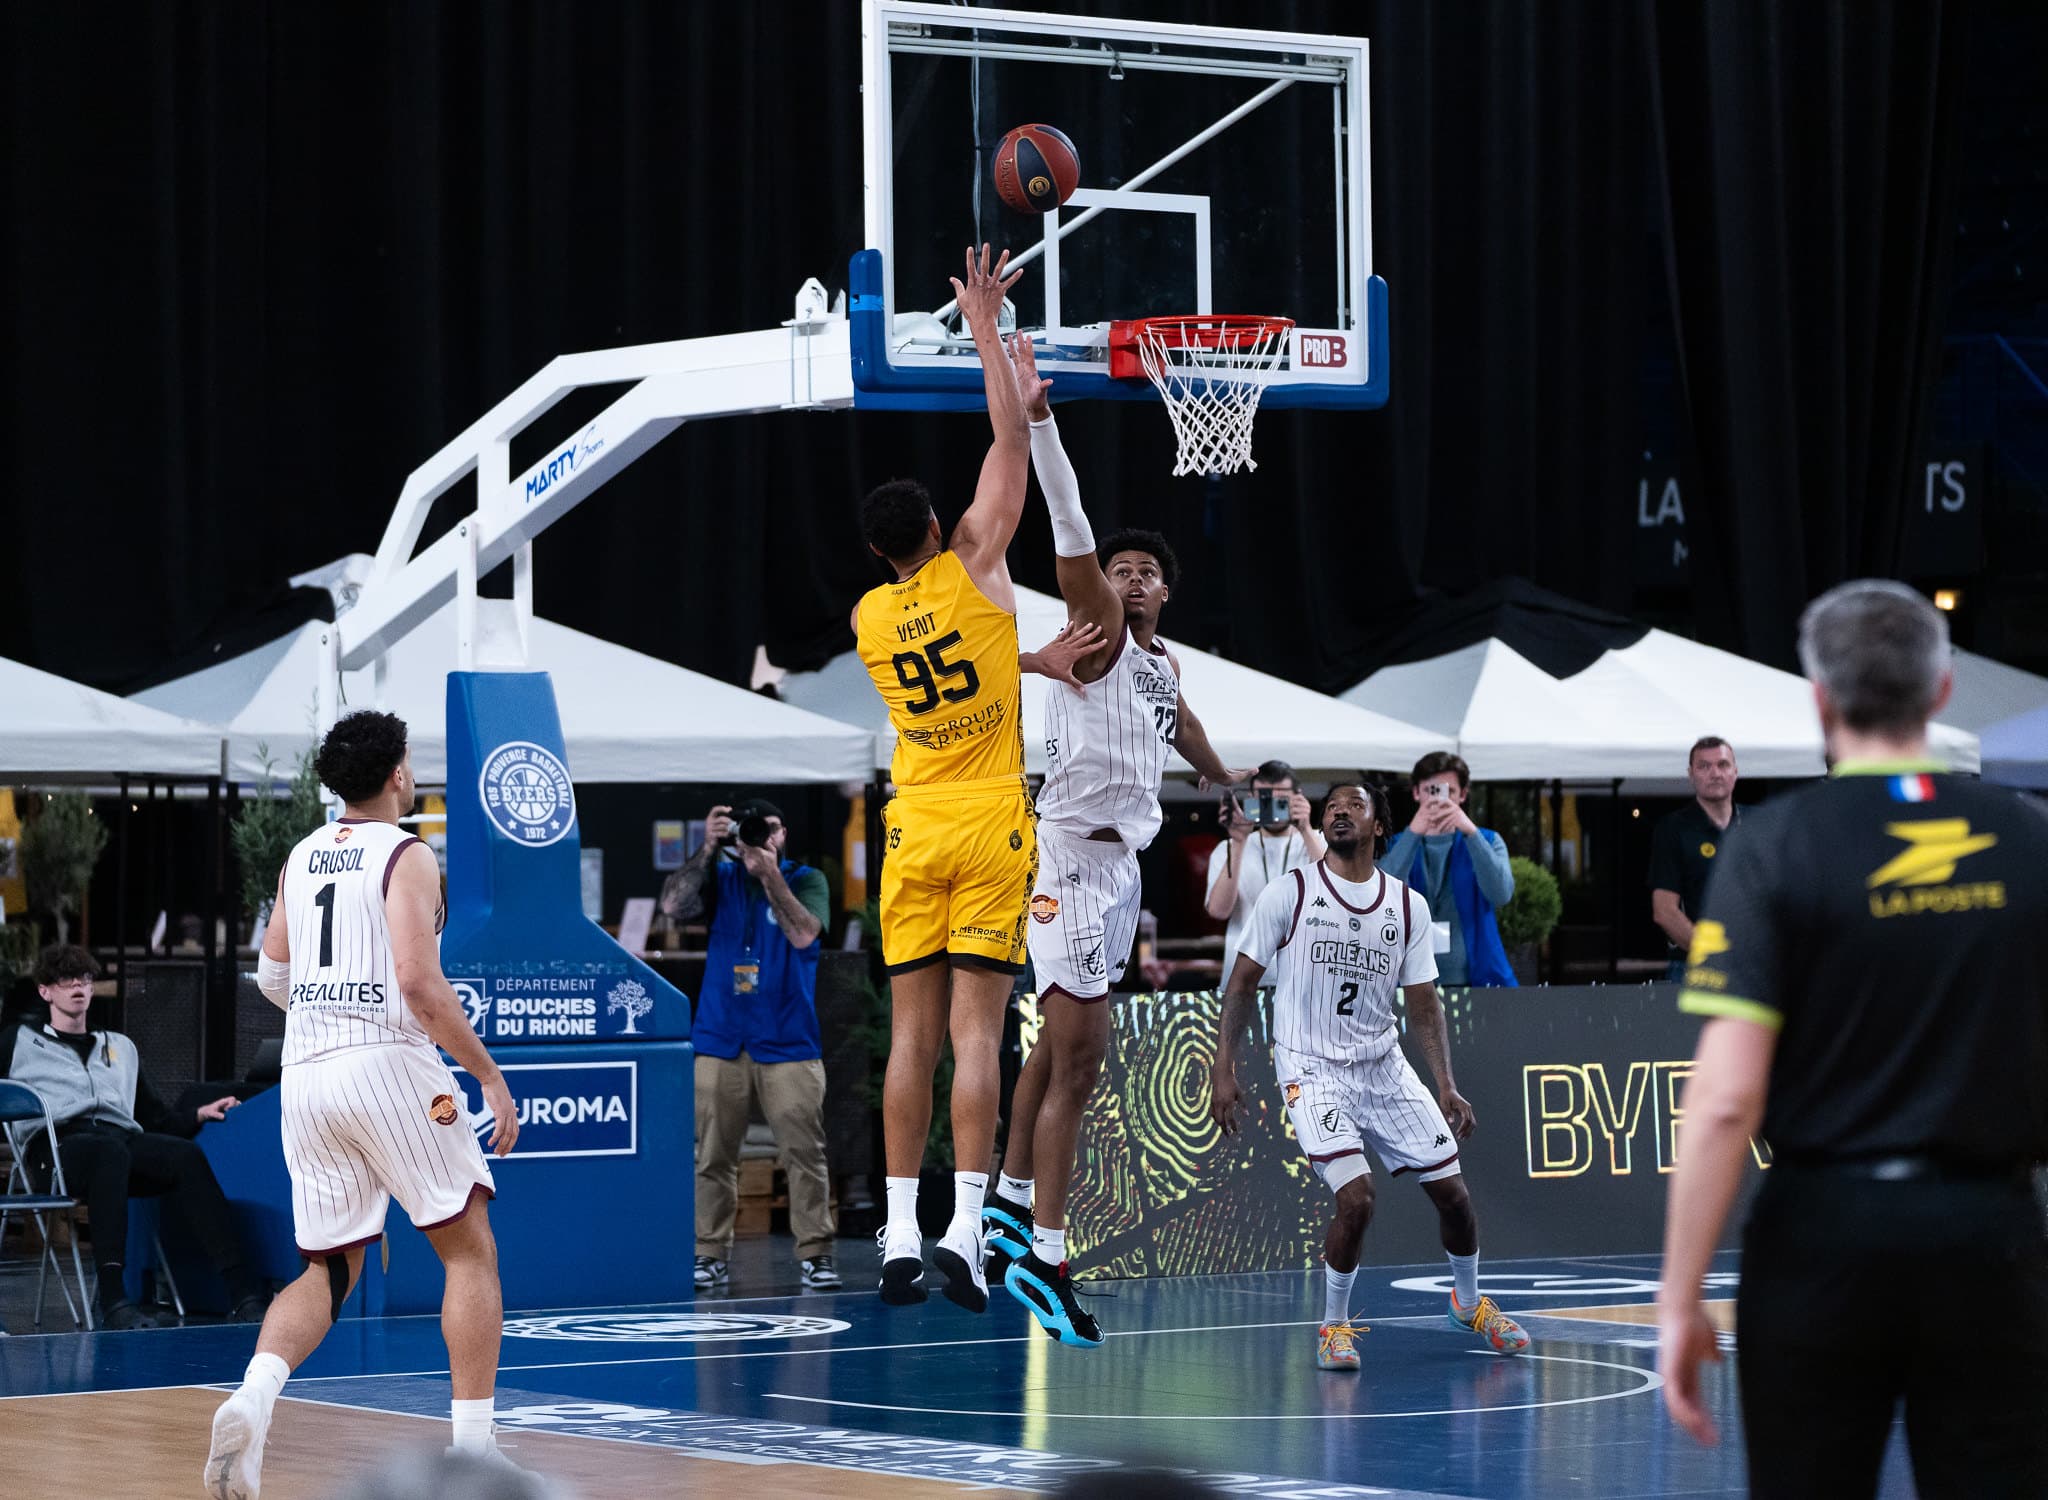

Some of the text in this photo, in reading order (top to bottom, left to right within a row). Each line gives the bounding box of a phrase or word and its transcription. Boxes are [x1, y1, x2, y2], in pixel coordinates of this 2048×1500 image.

[526, 444, 577, 503] MARTY
[896, 612, 936, 643] VENT
[891, 629, 981, 716] 95
[935, 698, 1005, 734] GROUPE
[1154, 705, 1176, 745] 22
[487, 786, 502, 808] FOS
[531, 751, 570, 808] BASKETBALL
[501, 786, 557, 802] BYERS
[524, 827, 547, 839] 1972
[889, 827, 902, 850] 95
[308, 848, 365, 874] CRUSOL
[1909, 880, 2008, 914] POSTE
[314, 882, 336, 968] 1
[960, 926, 1009, 940] METROPOLE
[1311, 939, 1391, 976] ORLÉANS
[496, 976, 597, 992] DÉPARTEMENT
[1336, 981, 1360, 1017] 2
[496, 998, 597, 1016] BOUCHES
[496, 1014, 597, 1036] DU RHÔNE
[512, 1095, 629, 1126] UROMA
